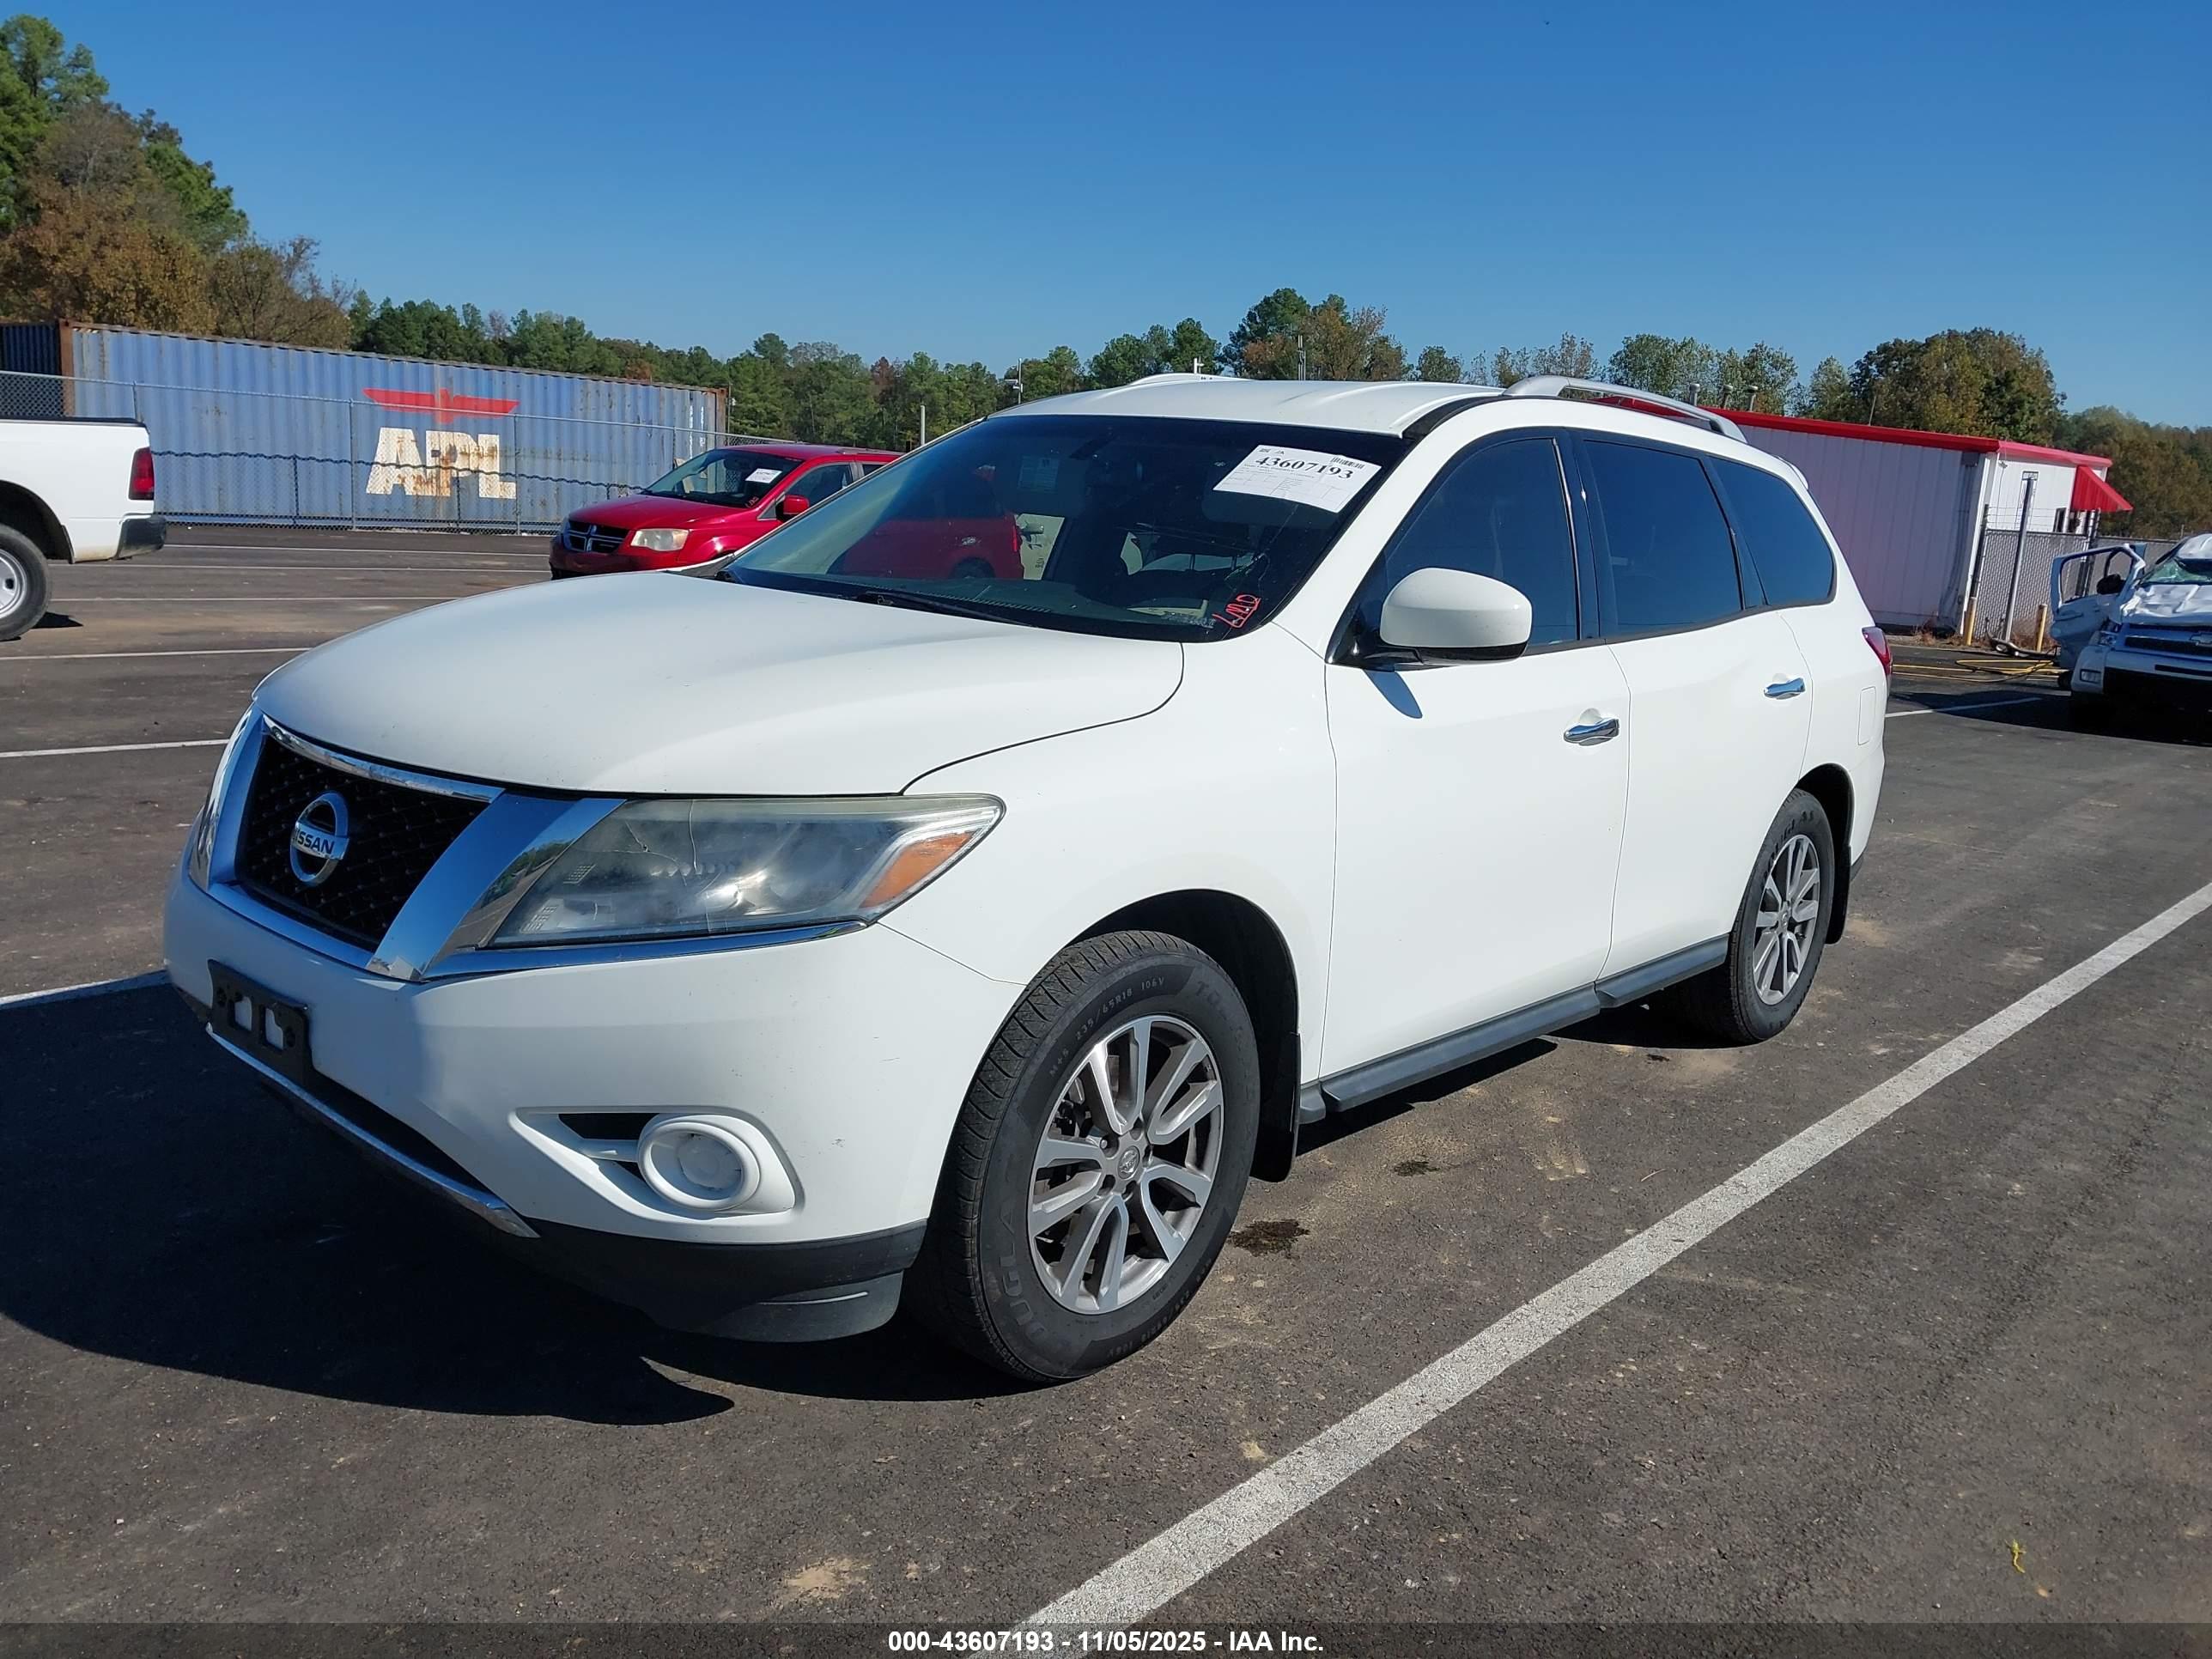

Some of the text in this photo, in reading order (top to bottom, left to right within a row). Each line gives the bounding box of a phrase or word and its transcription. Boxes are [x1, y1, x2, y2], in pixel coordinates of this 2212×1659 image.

[366, 427, 516, 500] APL
[1255, 455, 1354, 480] 43607193
[1074, 988, 1133, 1041] 235/65R18
[1140, 975, 1165, 991] 106V
